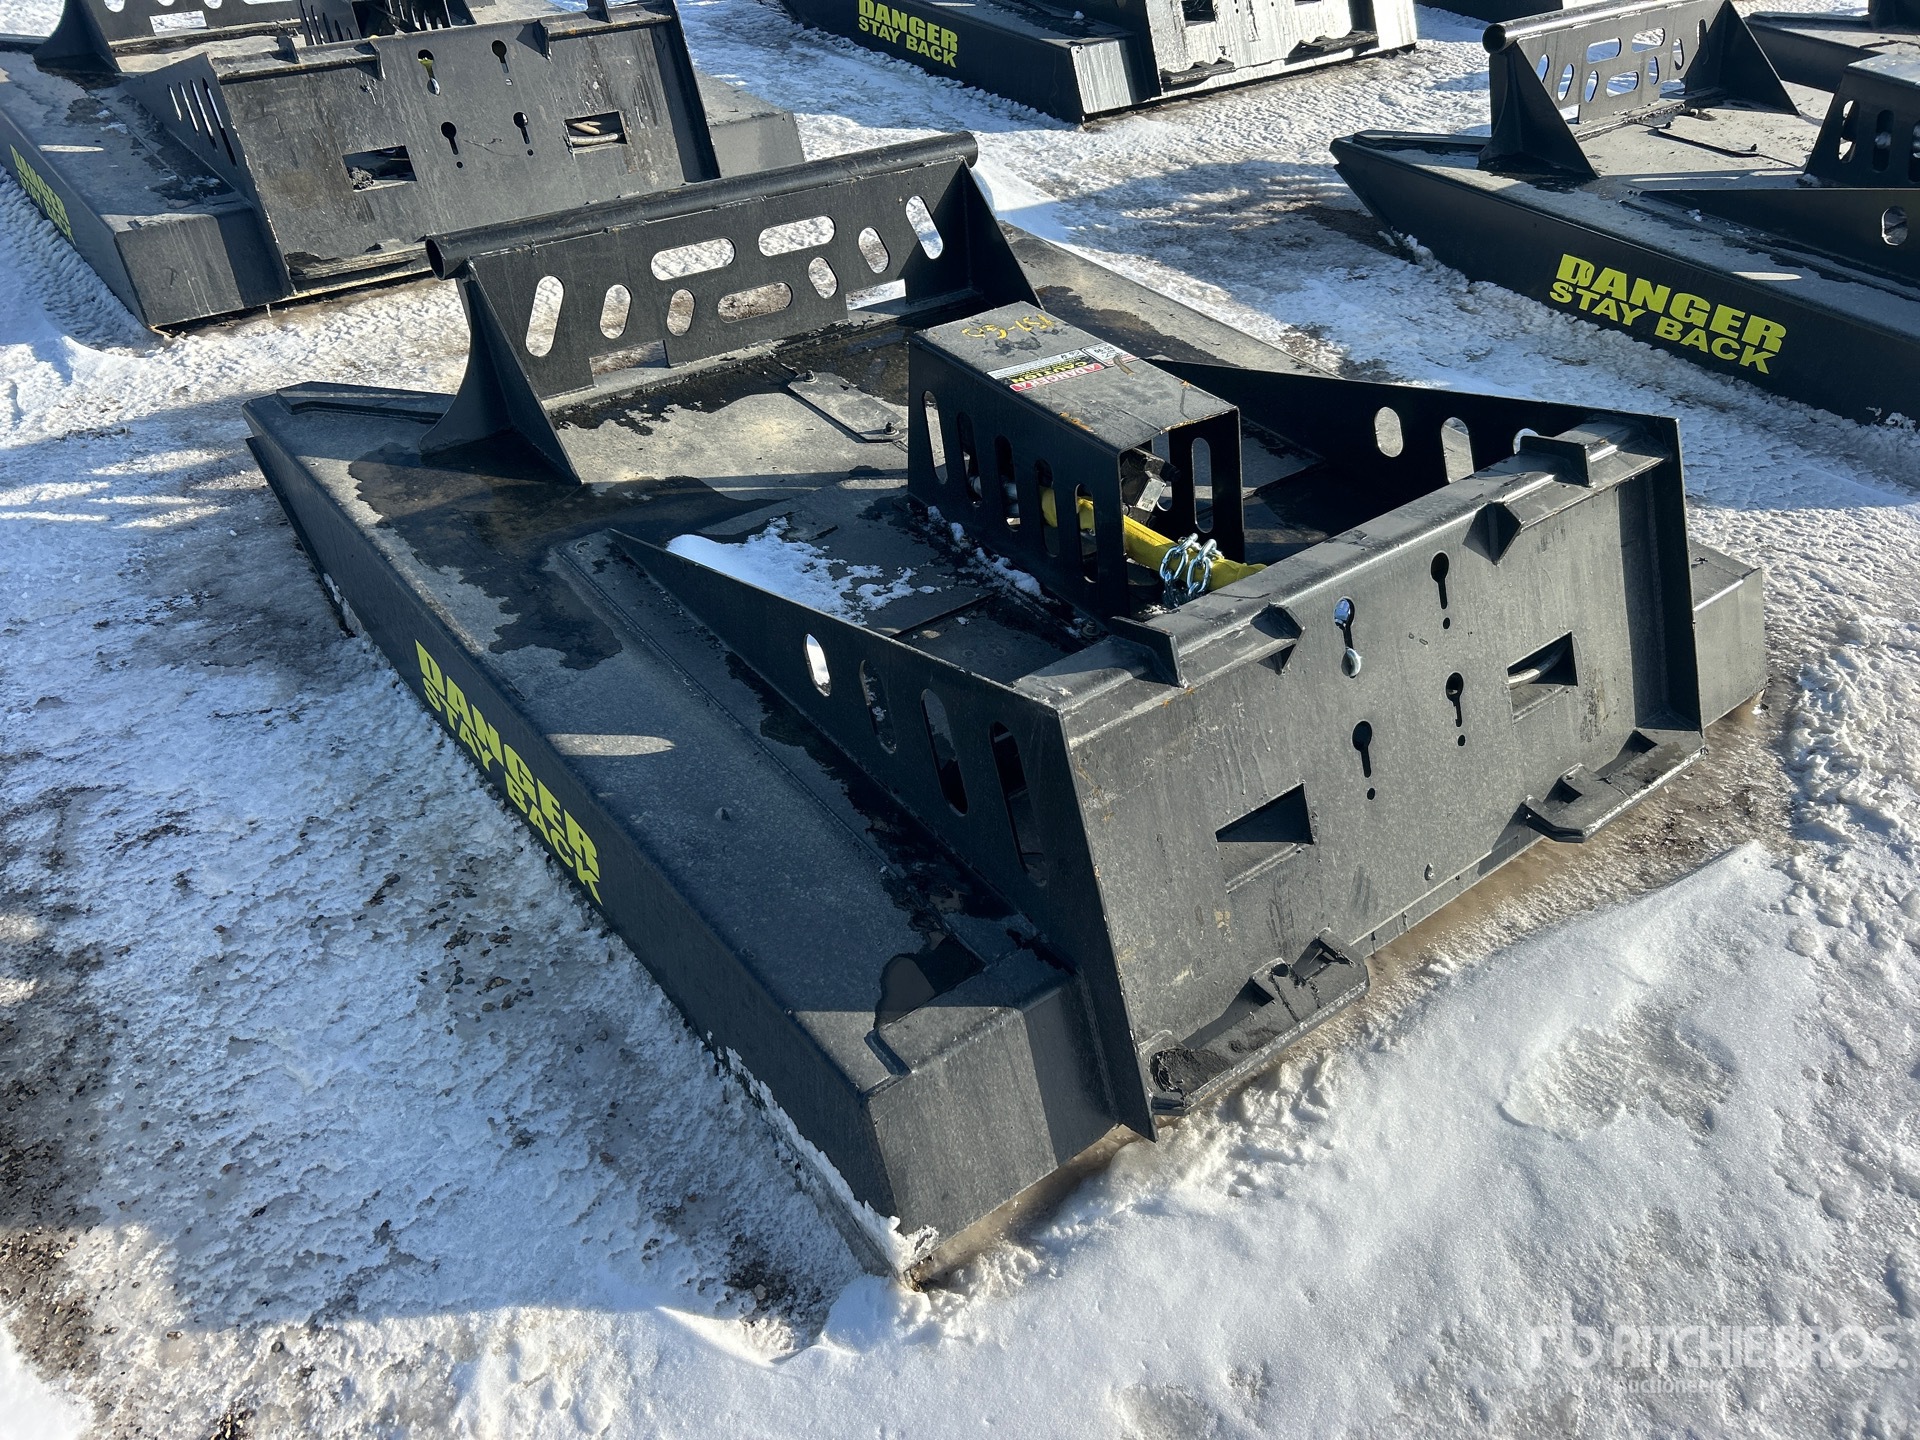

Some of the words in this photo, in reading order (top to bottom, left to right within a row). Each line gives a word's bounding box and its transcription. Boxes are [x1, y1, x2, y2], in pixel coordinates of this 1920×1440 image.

[858, 0, 958, 53] DANGER
[858, 16, 901, 44] STAY
[906, 34, 957, 68] BACK
[1549, 281, 1647, 327] STAY
[1654, 316, 1776, 375] BACK
[1555, 253, 1788, 354] DANGER
[1011, 360, 1088, 384] CAUTION
[414, 638, 600, 880] DANGER
[422, 677, 494, 772] STAY
[504, 771, 603, 906] BACK
